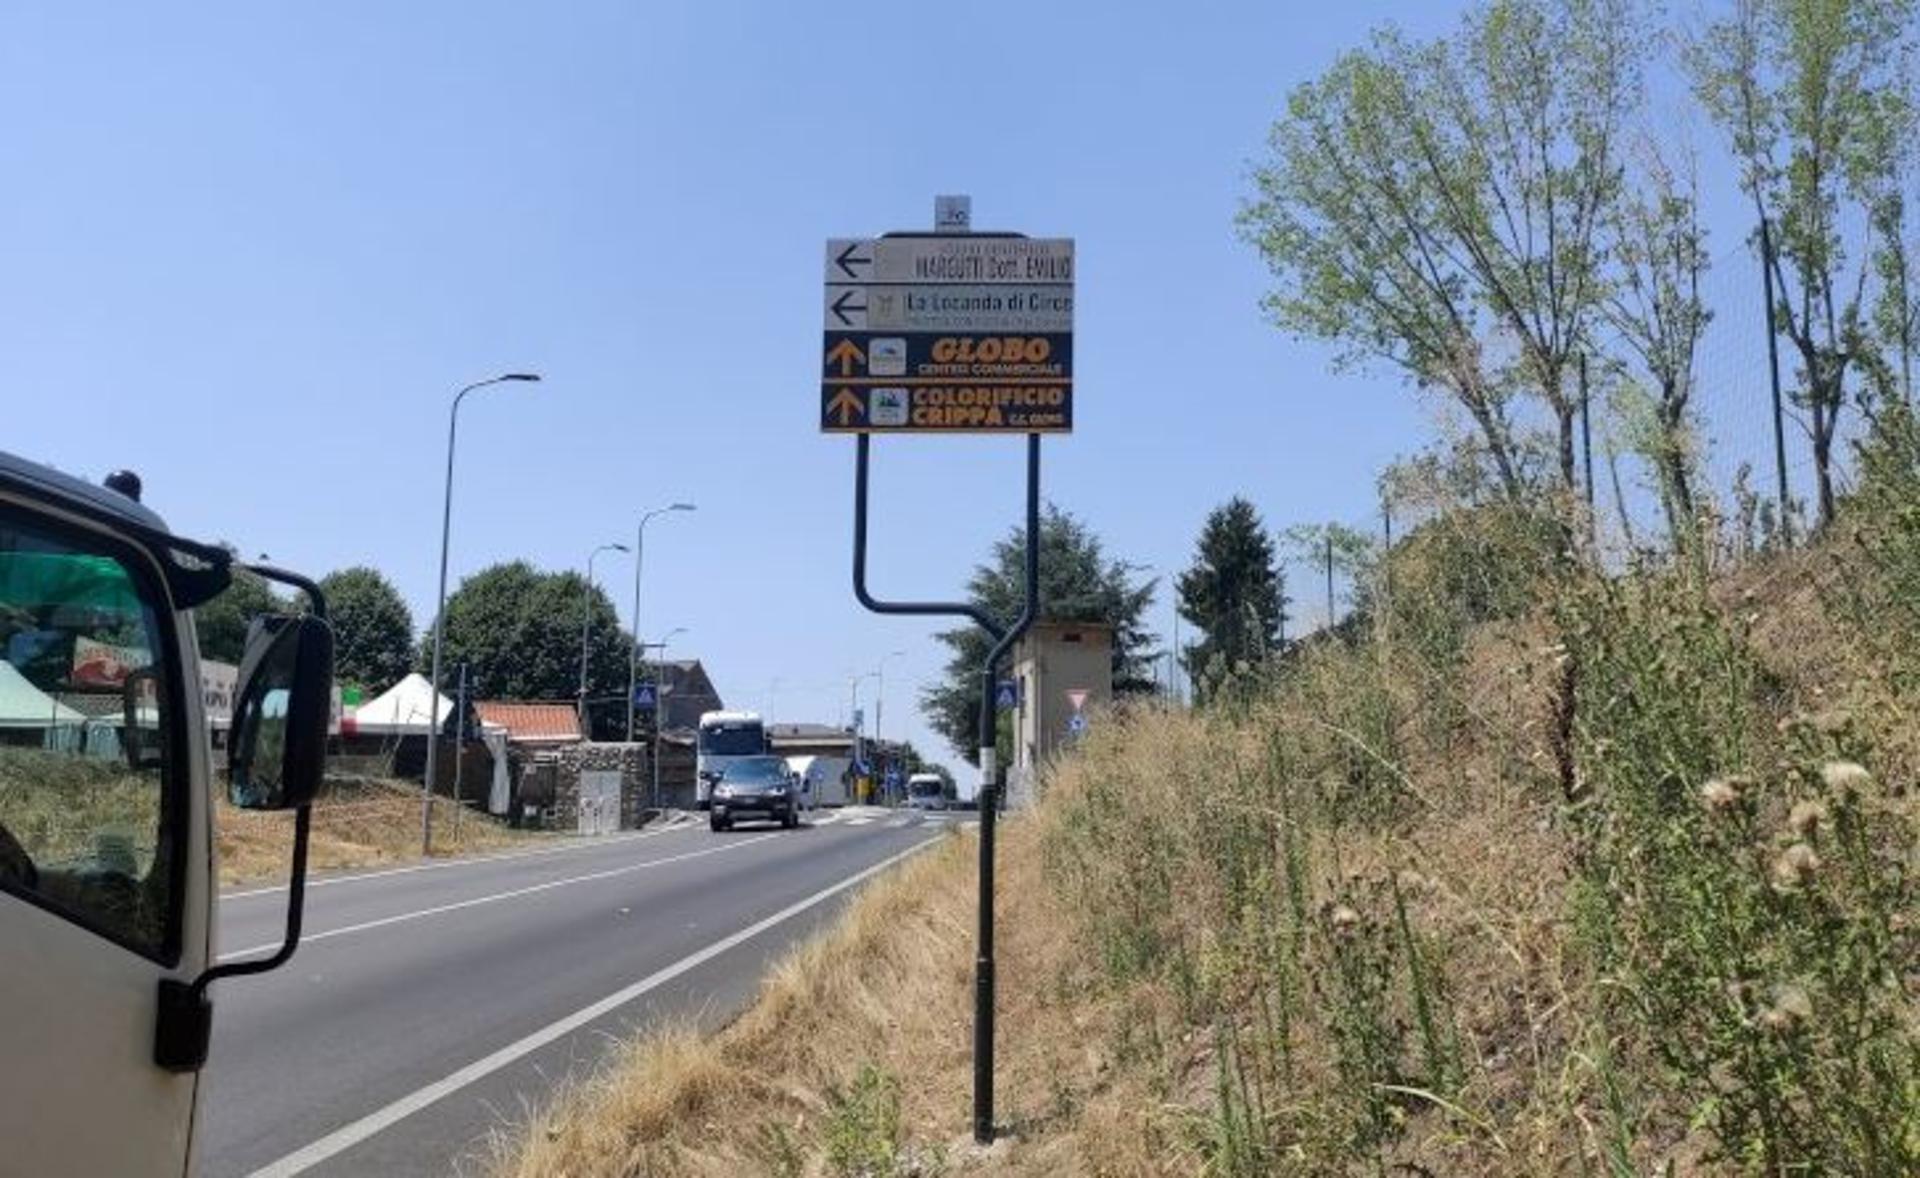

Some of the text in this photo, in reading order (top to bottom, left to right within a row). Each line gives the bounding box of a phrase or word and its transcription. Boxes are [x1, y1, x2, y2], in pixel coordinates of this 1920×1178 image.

[907, 291, 926, 311] La
[931, 292, 1003, 311] Locanda
[1007, 291, 1024, 311] di
[931, 336, 1050, 363] GLOBO
[912, 387, 1065, 406] COLORIFICIO
[911, 406, 1004, 426] CRIPPA
